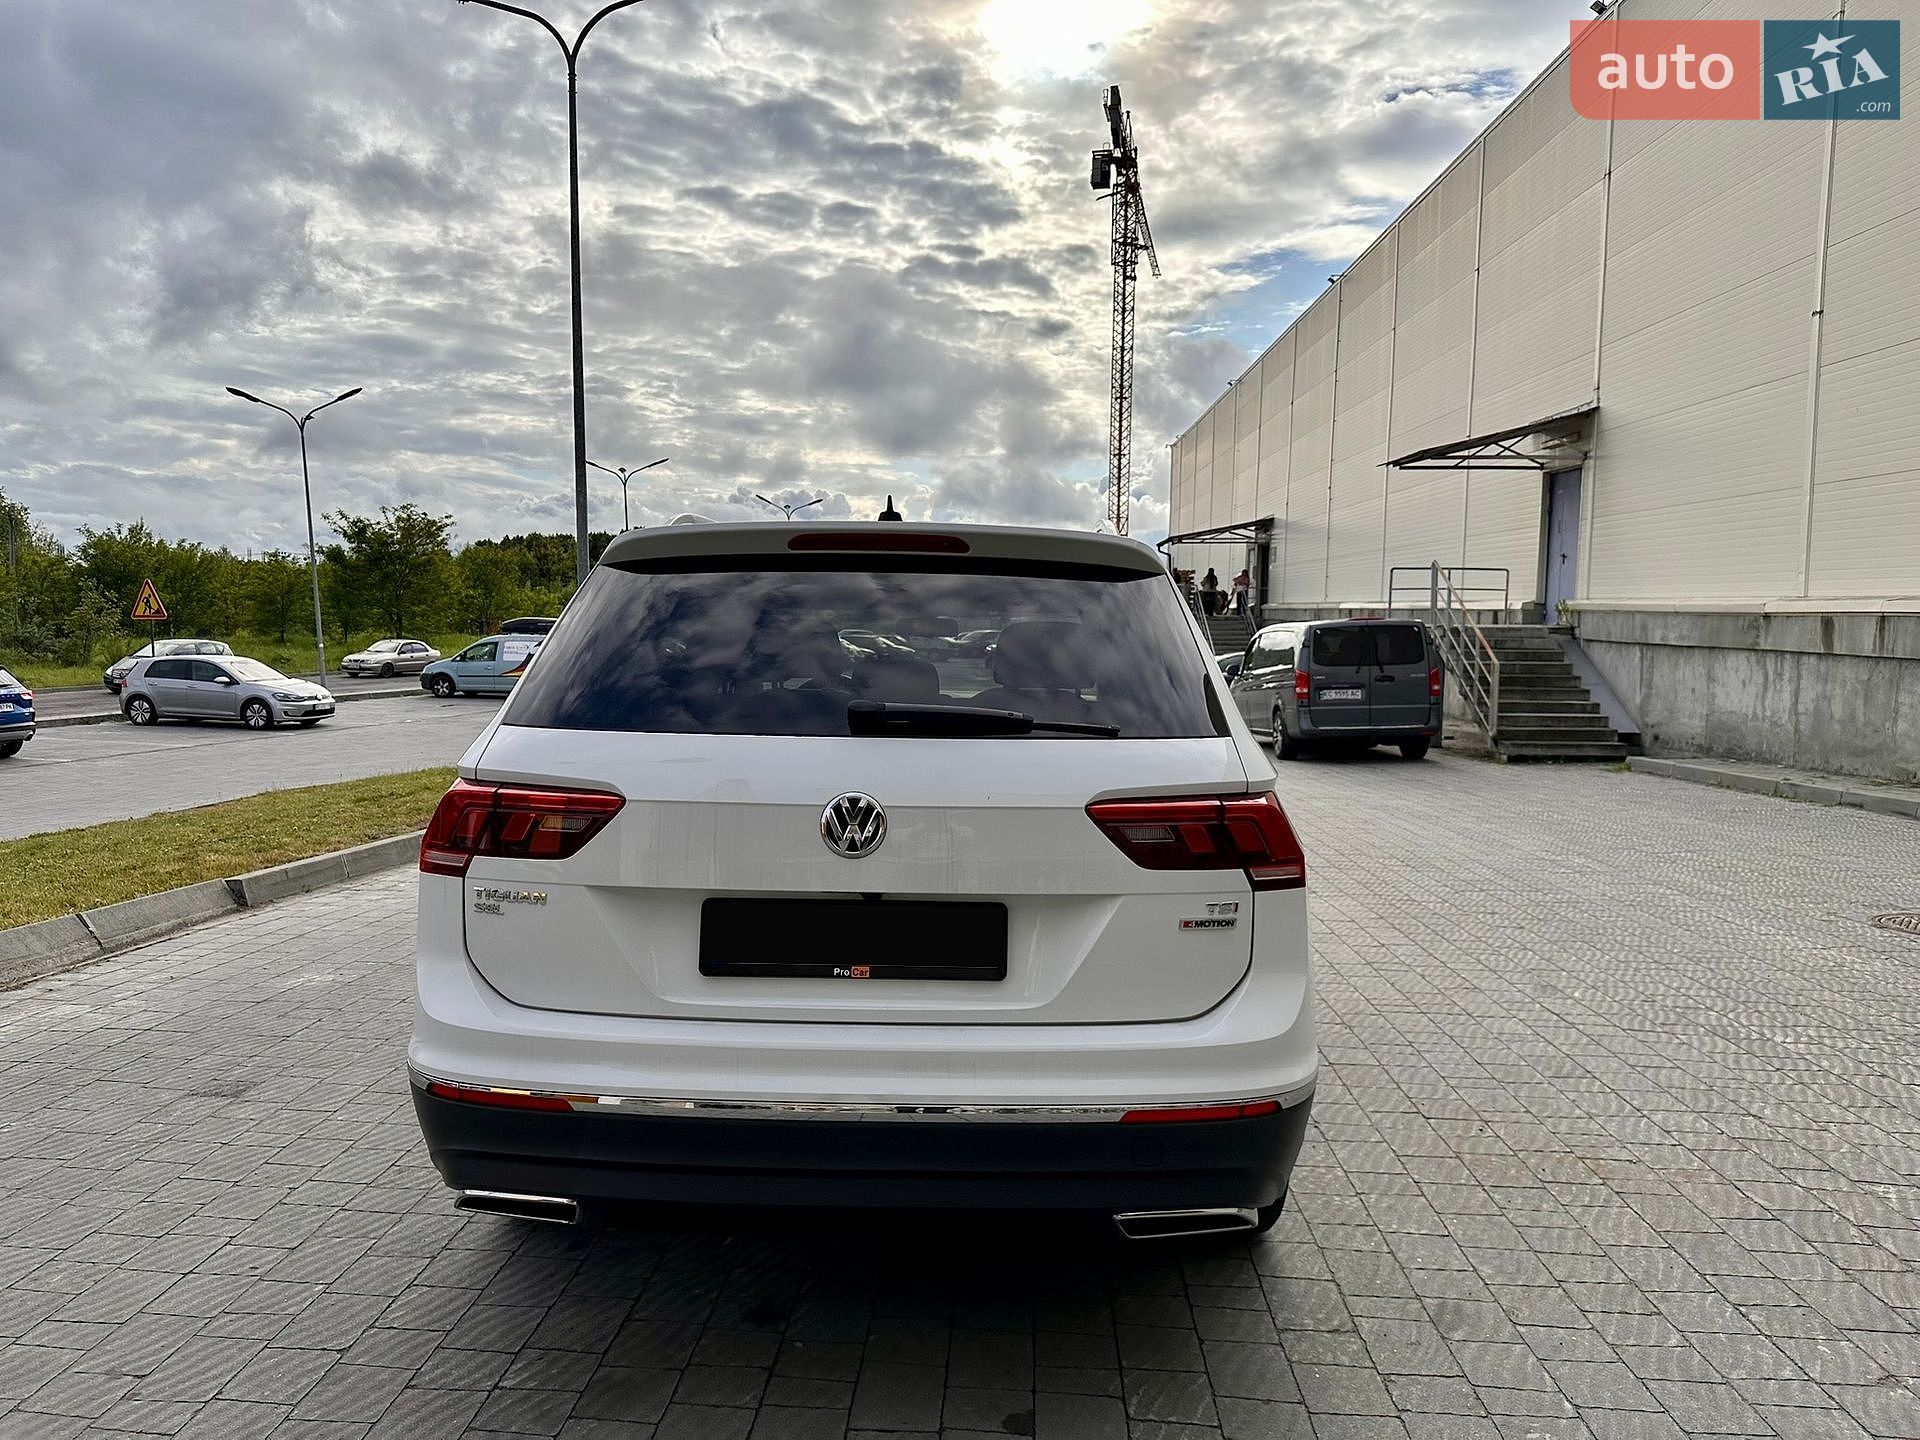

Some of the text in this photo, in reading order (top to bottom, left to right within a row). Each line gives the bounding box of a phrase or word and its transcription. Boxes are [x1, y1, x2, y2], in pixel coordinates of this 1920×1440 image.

[823, 795, 883, 856] VW
[474, 886, 548, 906] TIGUAN
[1205, 901, 1239, 915] TSI
